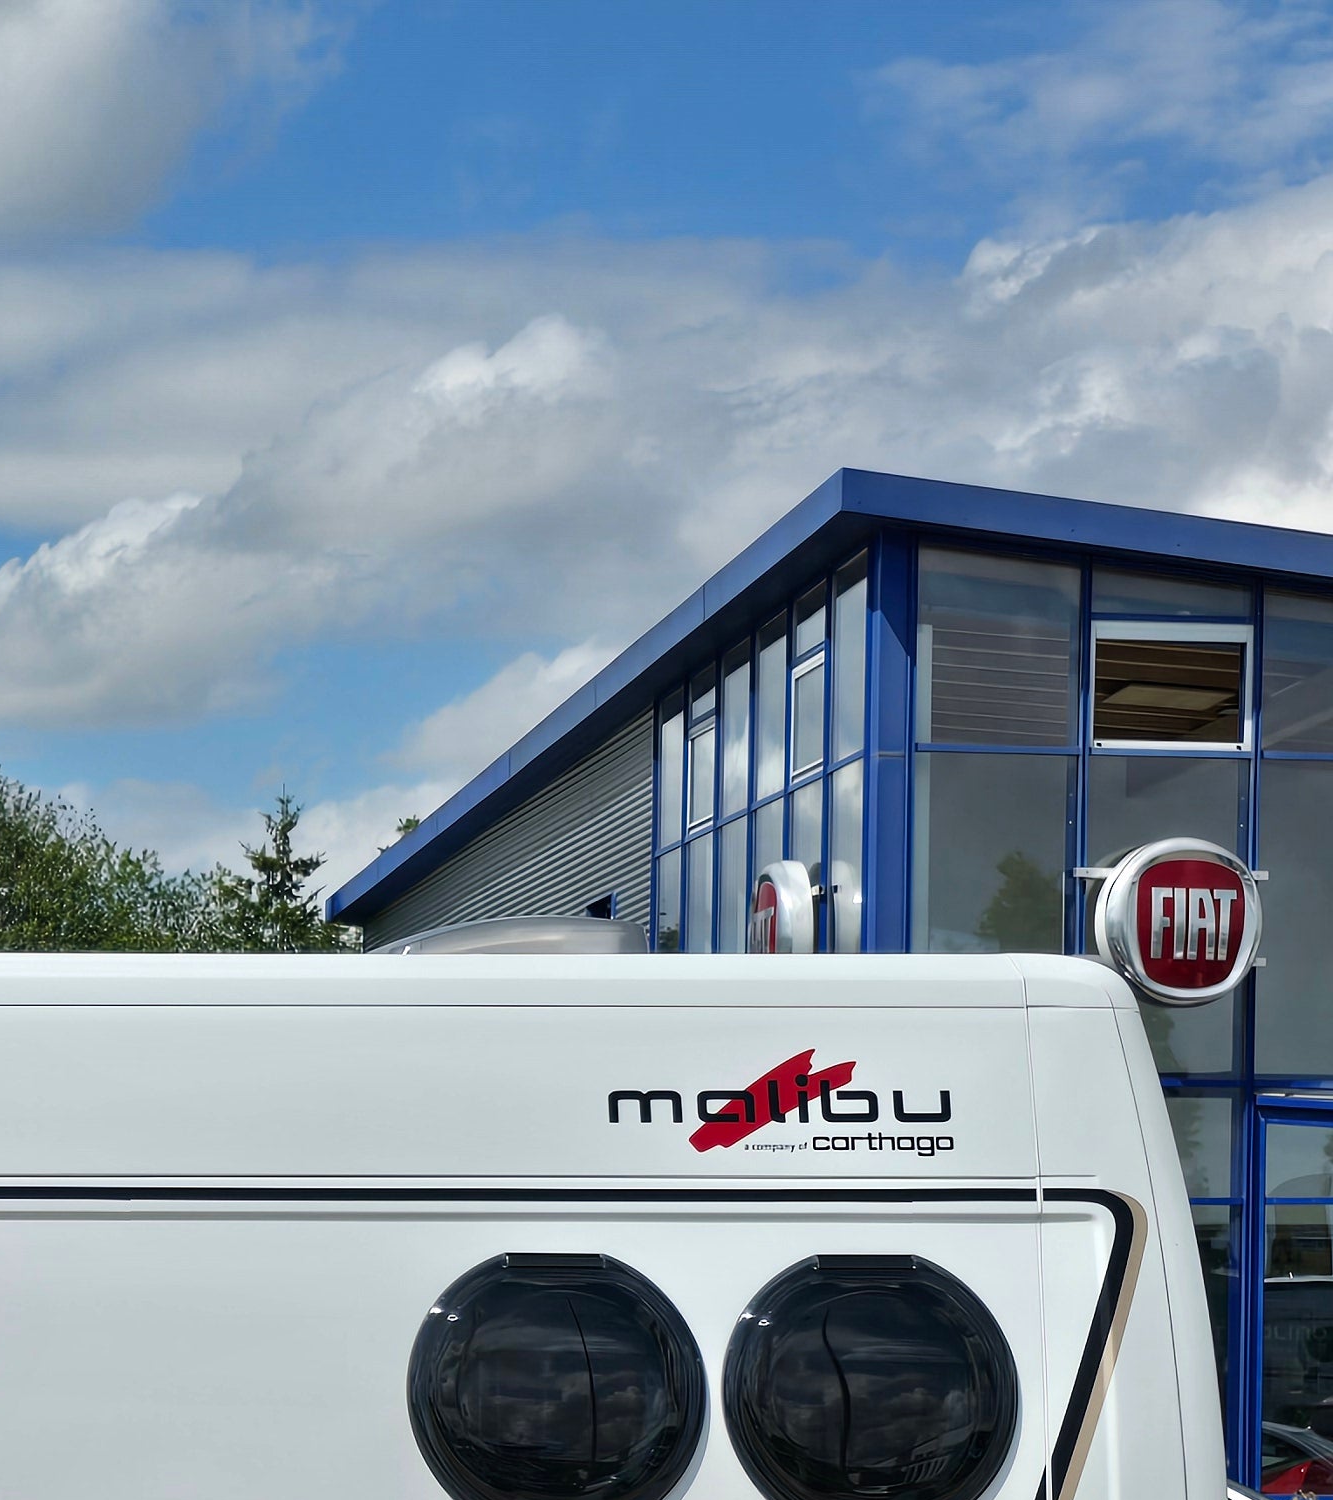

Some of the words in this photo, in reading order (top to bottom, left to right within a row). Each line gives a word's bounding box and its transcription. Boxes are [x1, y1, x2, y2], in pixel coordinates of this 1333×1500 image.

[1150, 886, 1238, 961] FIAT
[607, 1074, 952, 1124] malibu
[812, 1132, 955, 1157] carthago
